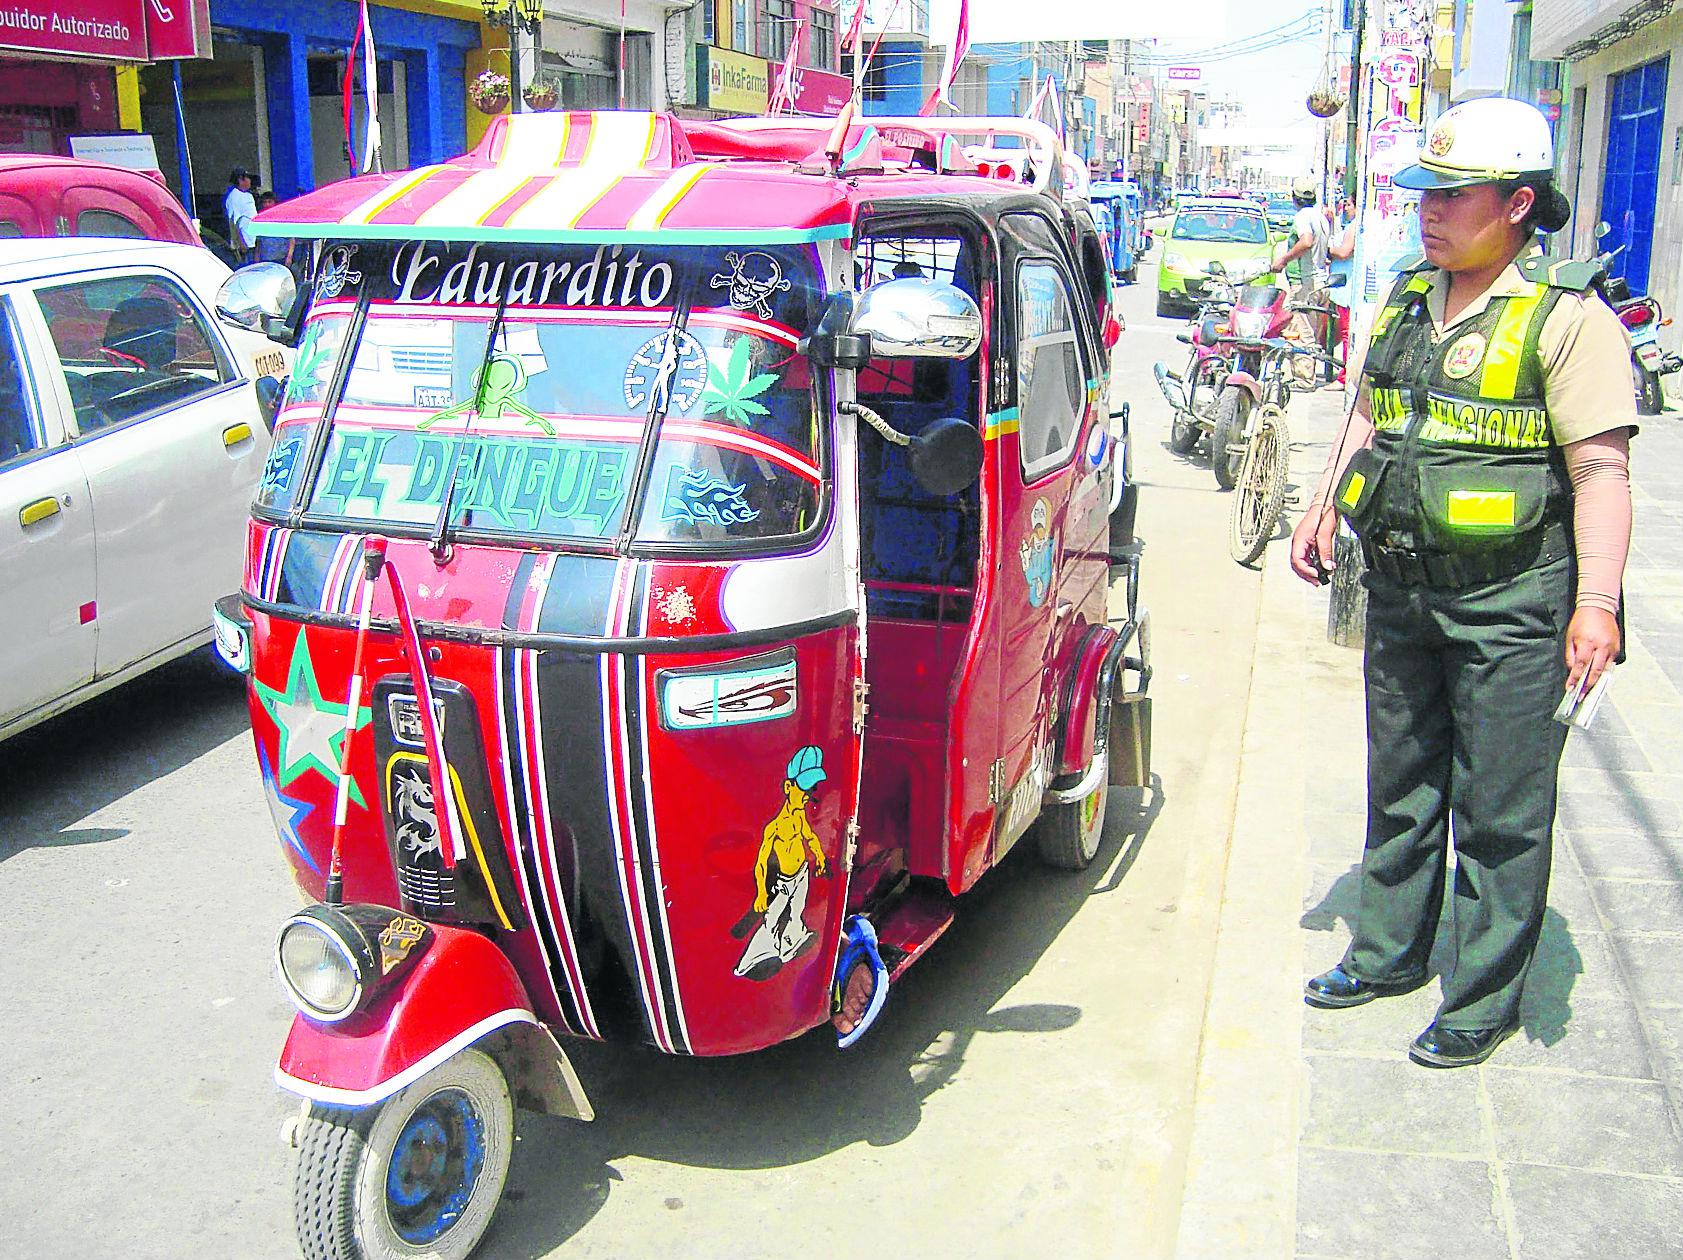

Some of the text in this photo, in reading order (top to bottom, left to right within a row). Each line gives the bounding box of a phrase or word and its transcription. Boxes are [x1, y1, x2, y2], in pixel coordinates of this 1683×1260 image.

[51, 12, 130, 41] Autorizado
[723, 62, 767, 94] InkaFarma
[392, 239, 673, 307] Eduardito
[1418, 399, 1550, 449] NACIONAL
[319, 430, 628, 536] EL DENGUE
